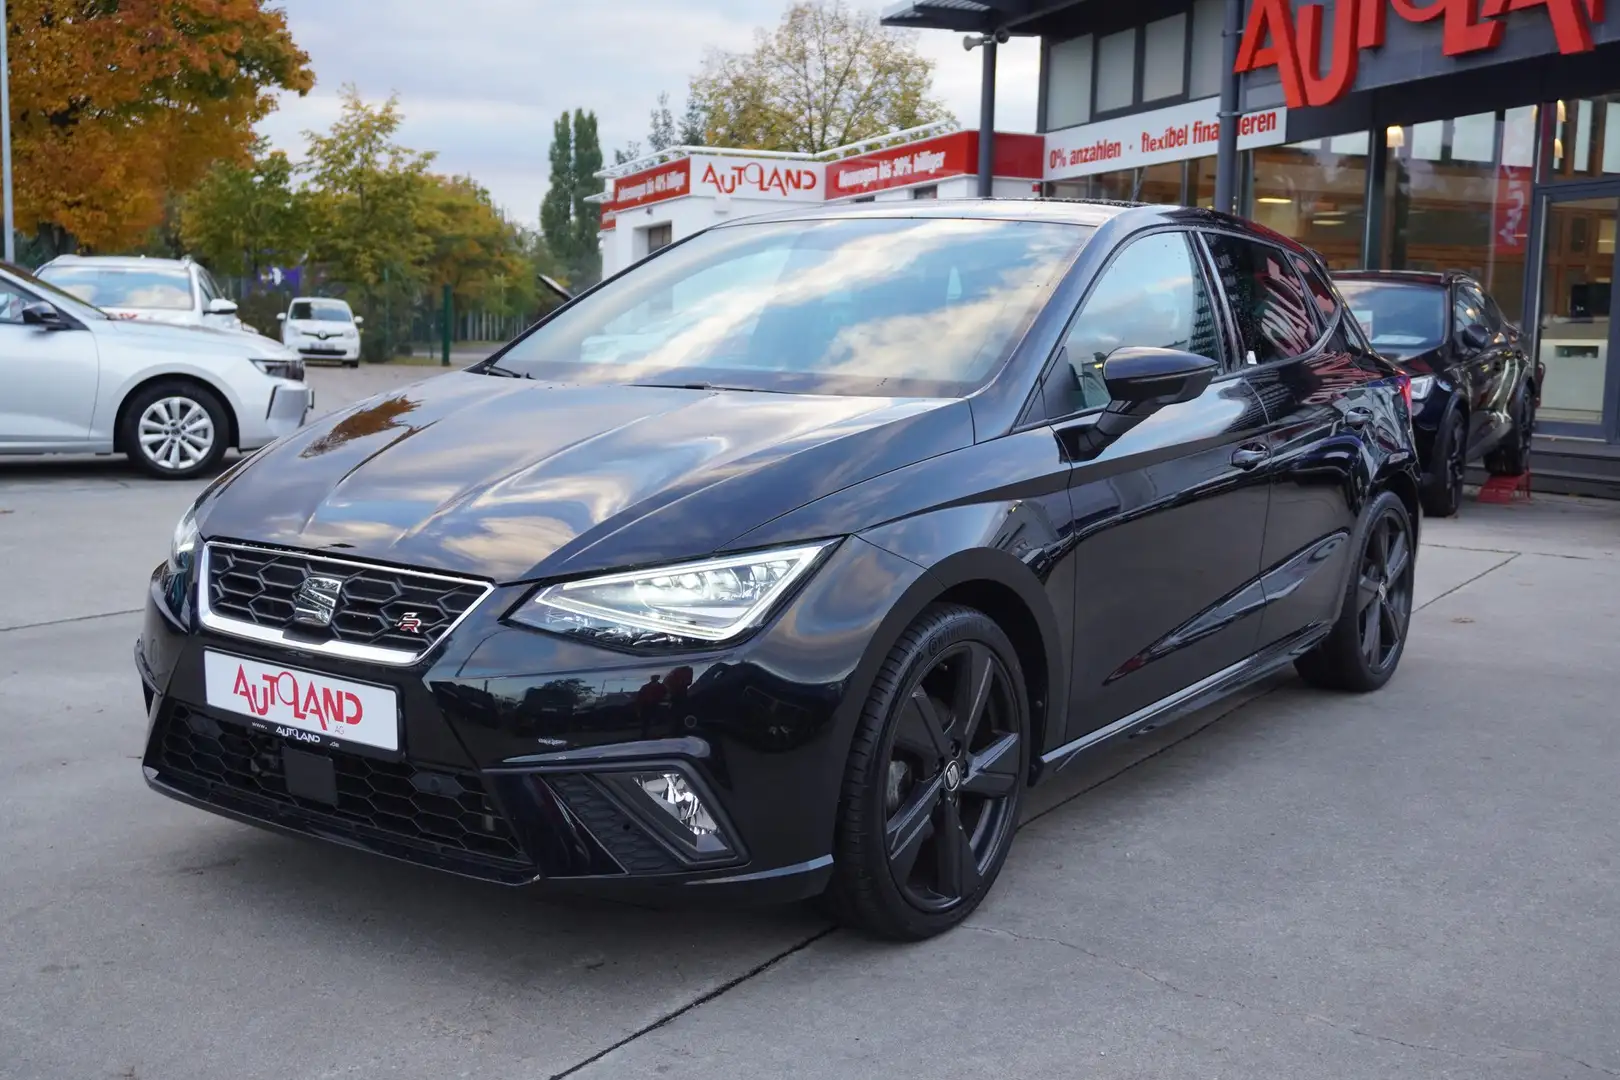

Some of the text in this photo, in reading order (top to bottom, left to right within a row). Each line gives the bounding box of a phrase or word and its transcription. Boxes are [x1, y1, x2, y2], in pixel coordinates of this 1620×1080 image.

[1049, 110, 1277, 169] 0% anzahlen flexibel finaieren
[700, 161, 817, 196] AUTOLAND
[233, 663, 363, 731] AUTOLAND
[275, 725, 321, 744] AUTOLAND
